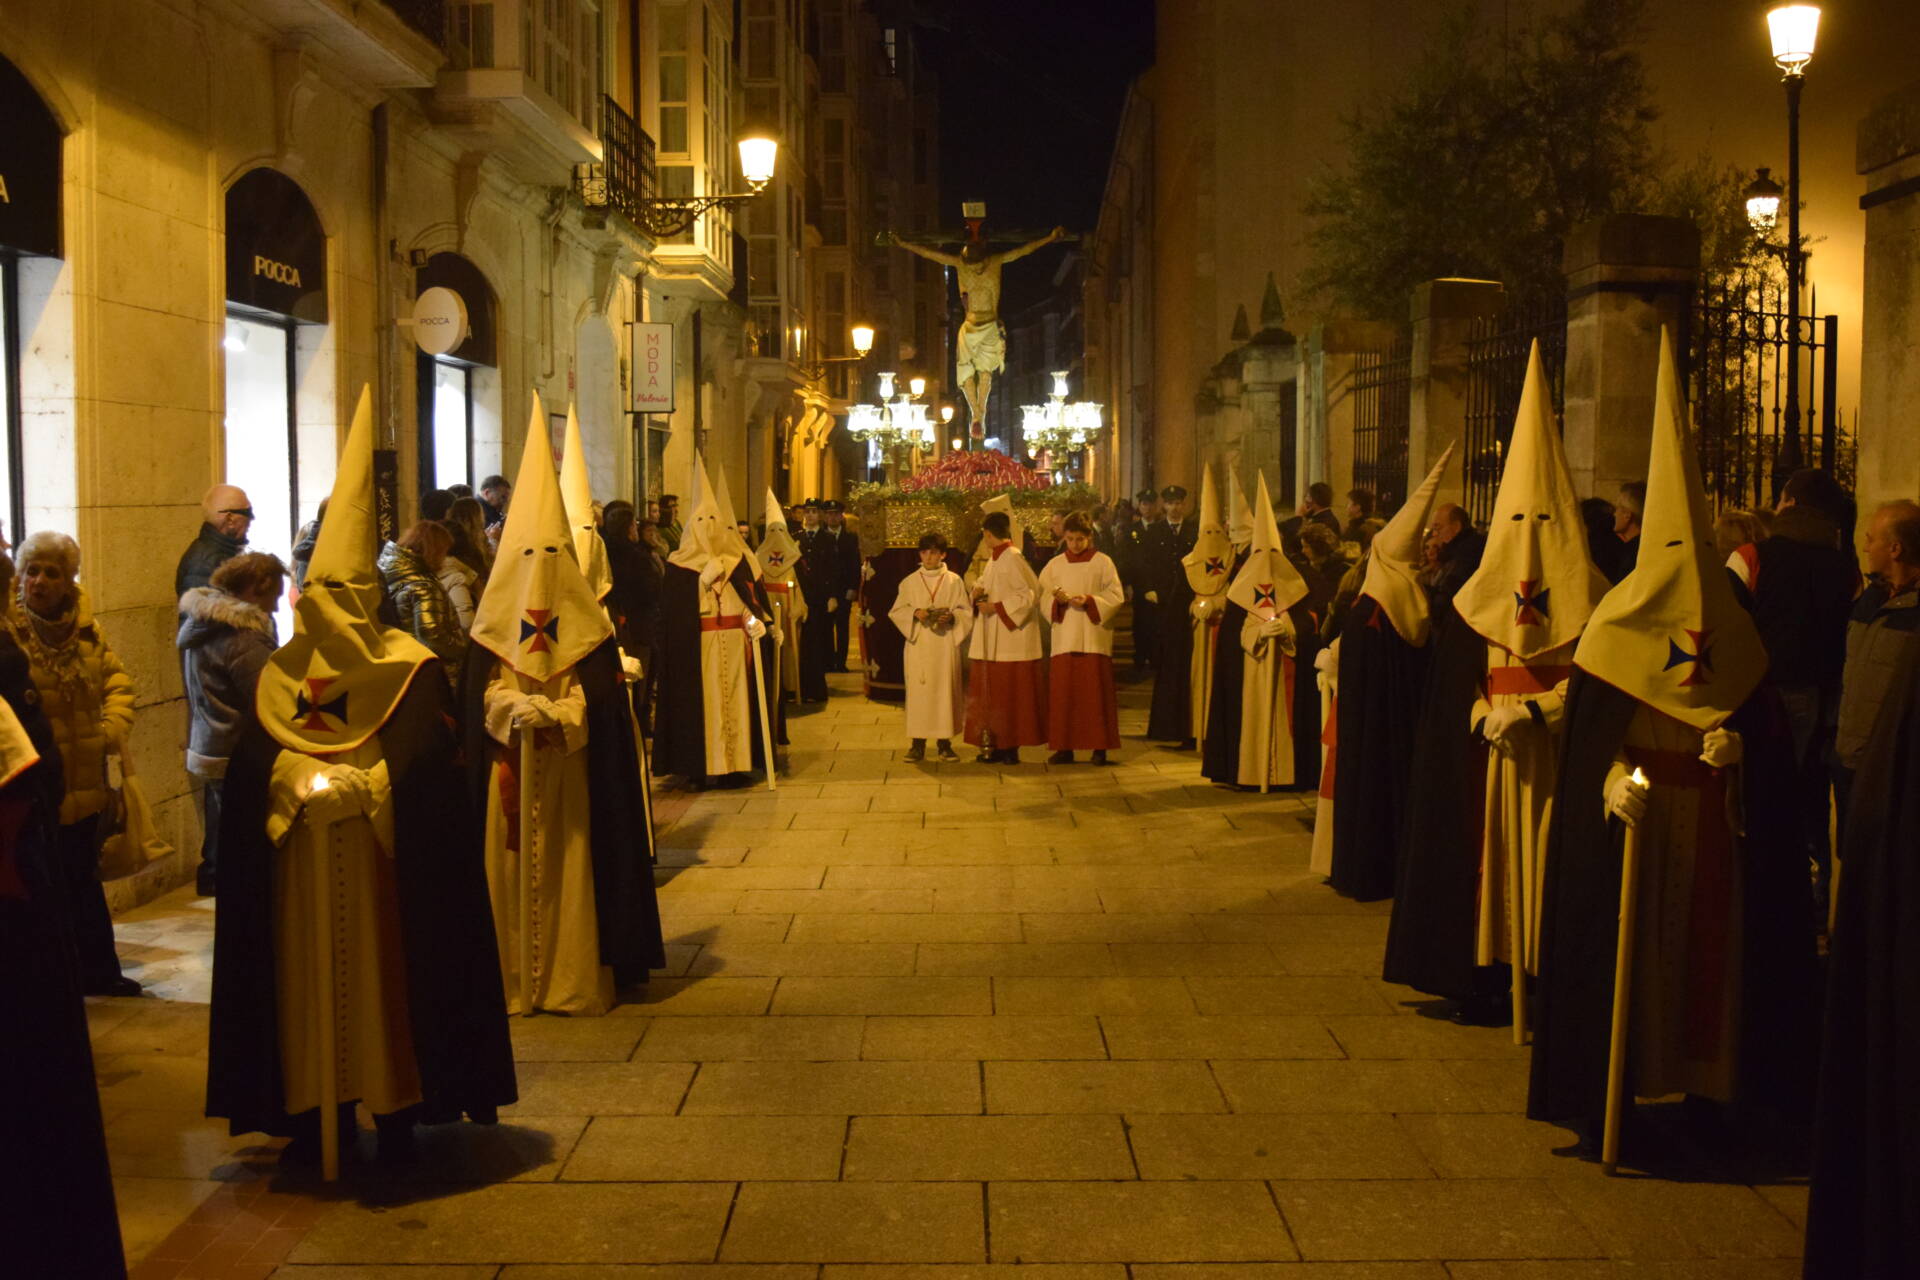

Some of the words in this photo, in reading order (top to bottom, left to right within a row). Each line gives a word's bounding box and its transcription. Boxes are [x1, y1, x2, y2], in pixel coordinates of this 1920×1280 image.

[255, 255, 302, 288] POCCA
[419, 317, 450, 325] POCCA
[647, 333, 659, 388] MODA
